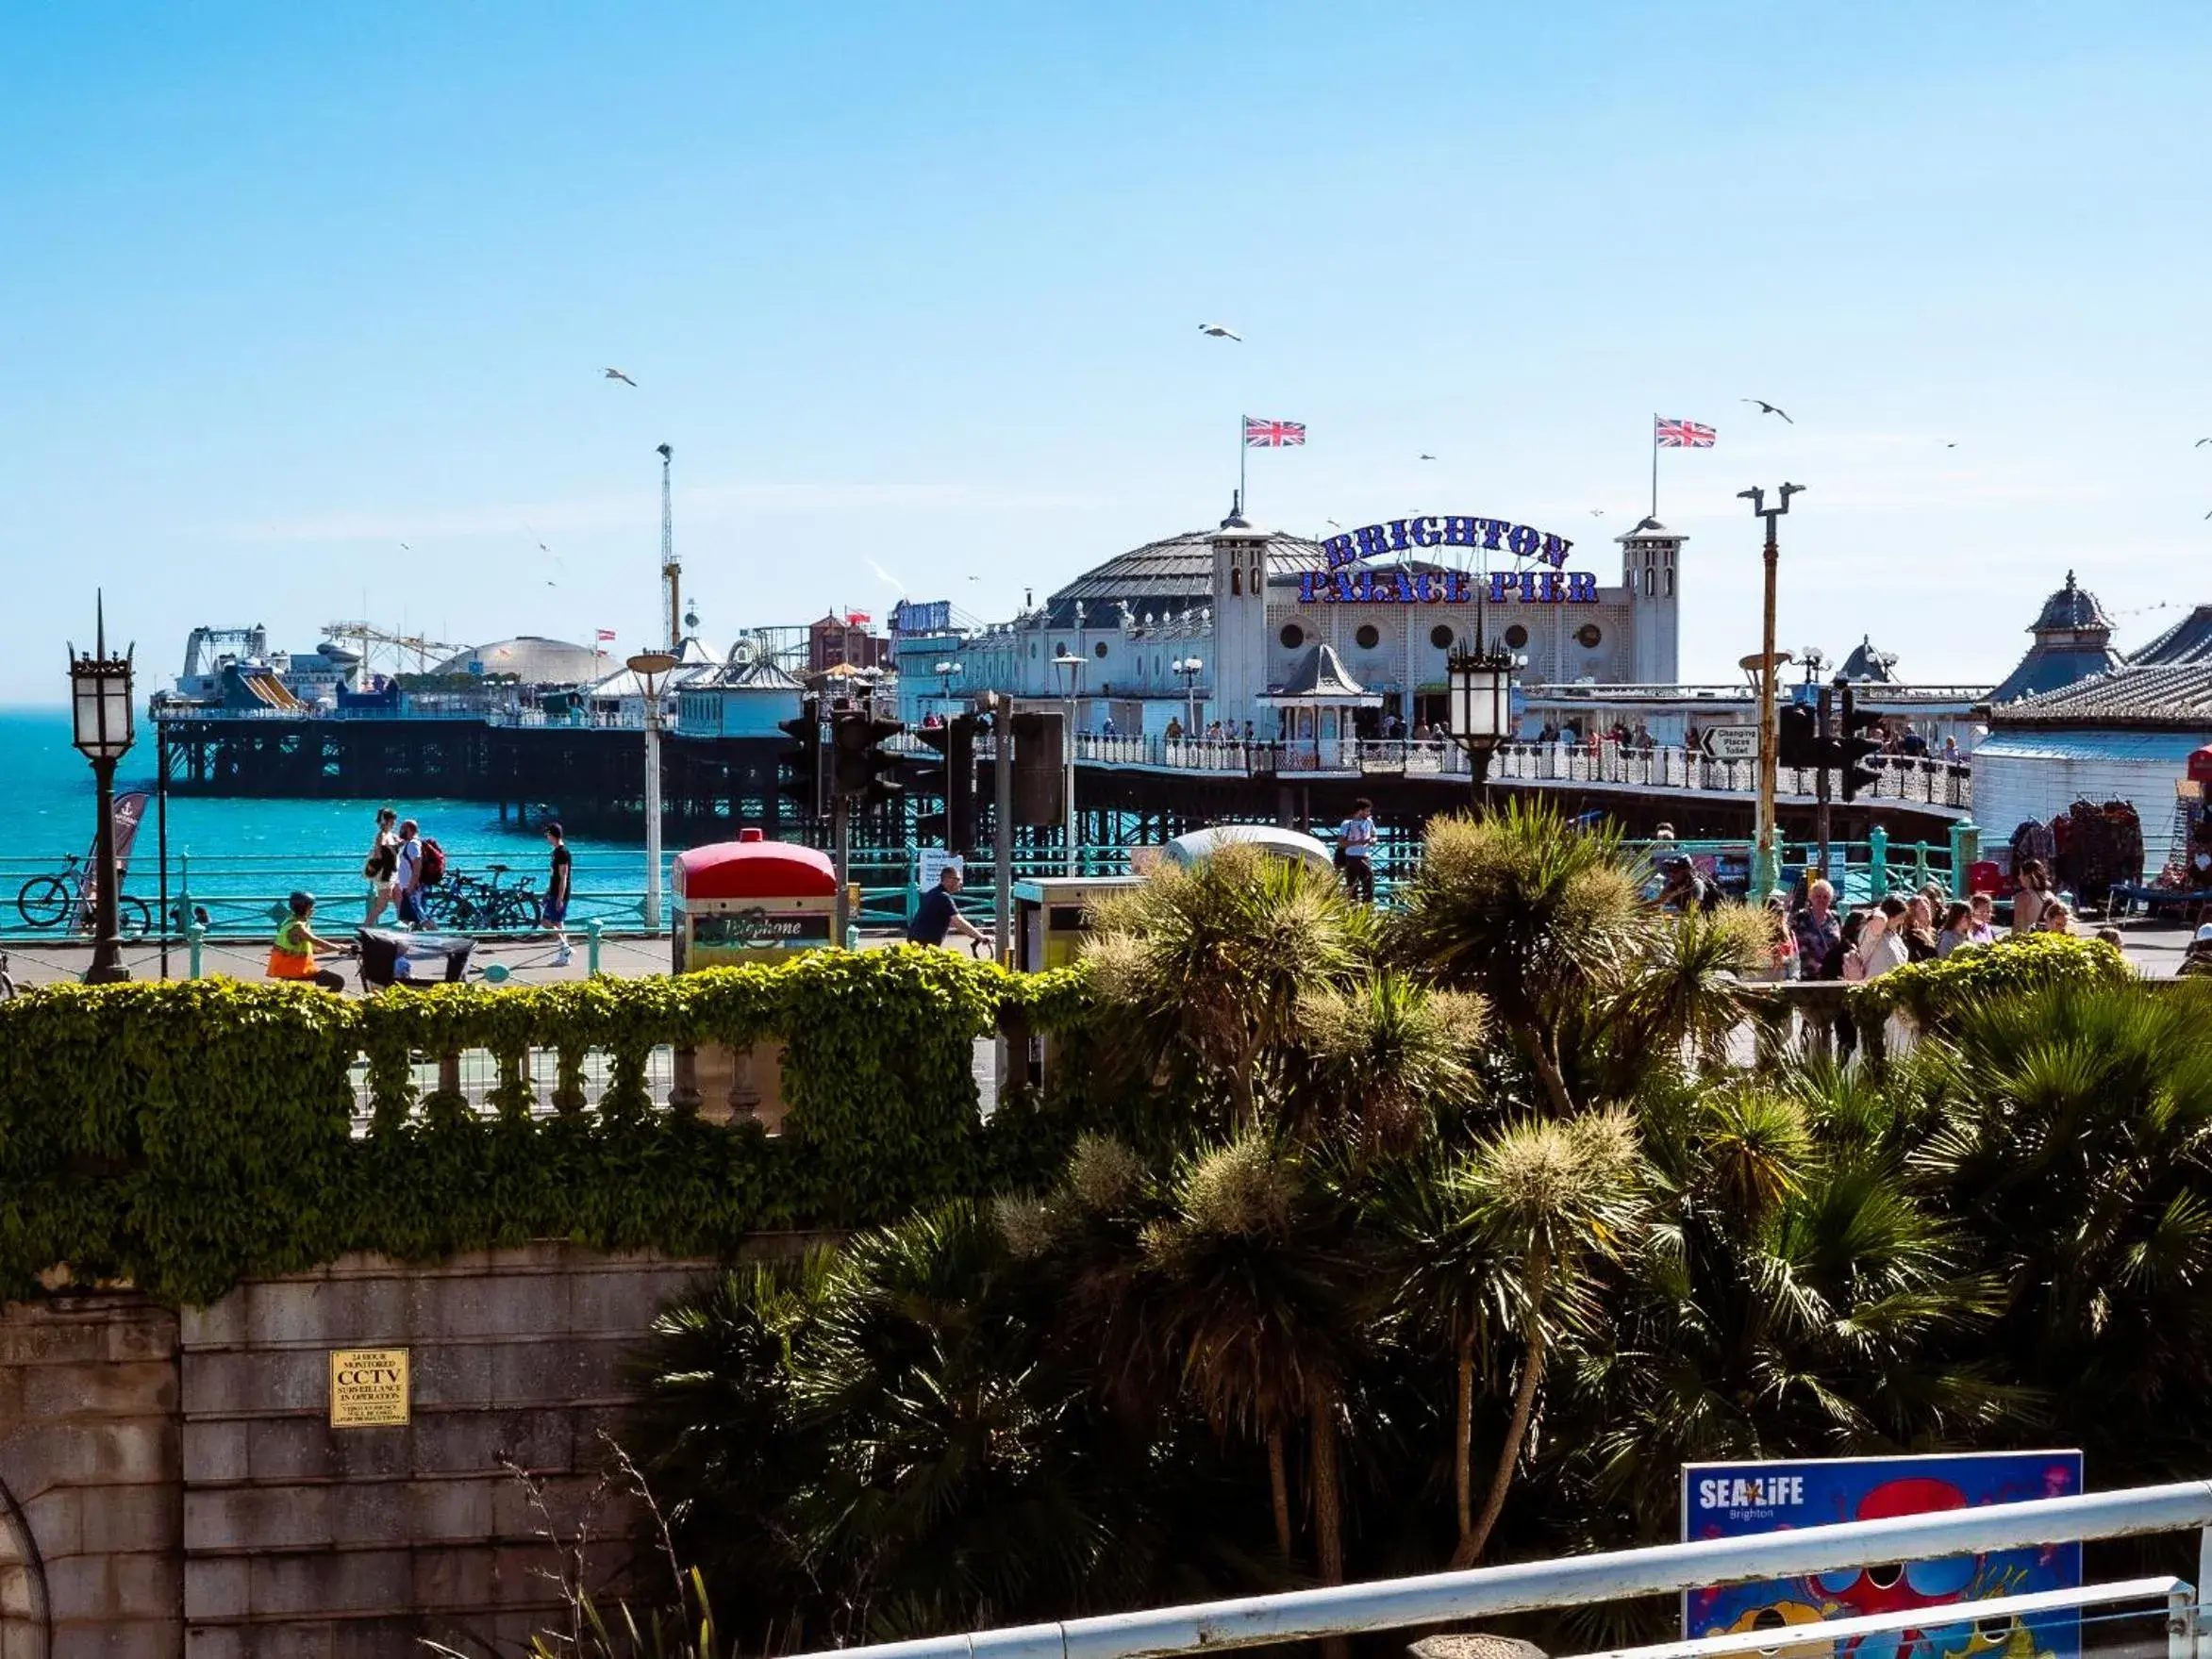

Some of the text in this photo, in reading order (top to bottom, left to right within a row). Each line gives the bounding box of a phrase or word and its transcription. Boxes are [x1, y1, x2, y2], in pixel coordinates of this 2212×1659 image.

[1322, 516, 1573, 570] BRIGHTON
[1299, 572, 1600, 604] PALACE PIER
[724, 919, 802, 938] Telephone
[338, 1369, 401, 1385] CCTV
[339, 1385, 401, 1393] SURVEILLANCE
[1700, 1479, 1748, 1509] SEA
[1730, 1508, 1773, 1521] Brighton
